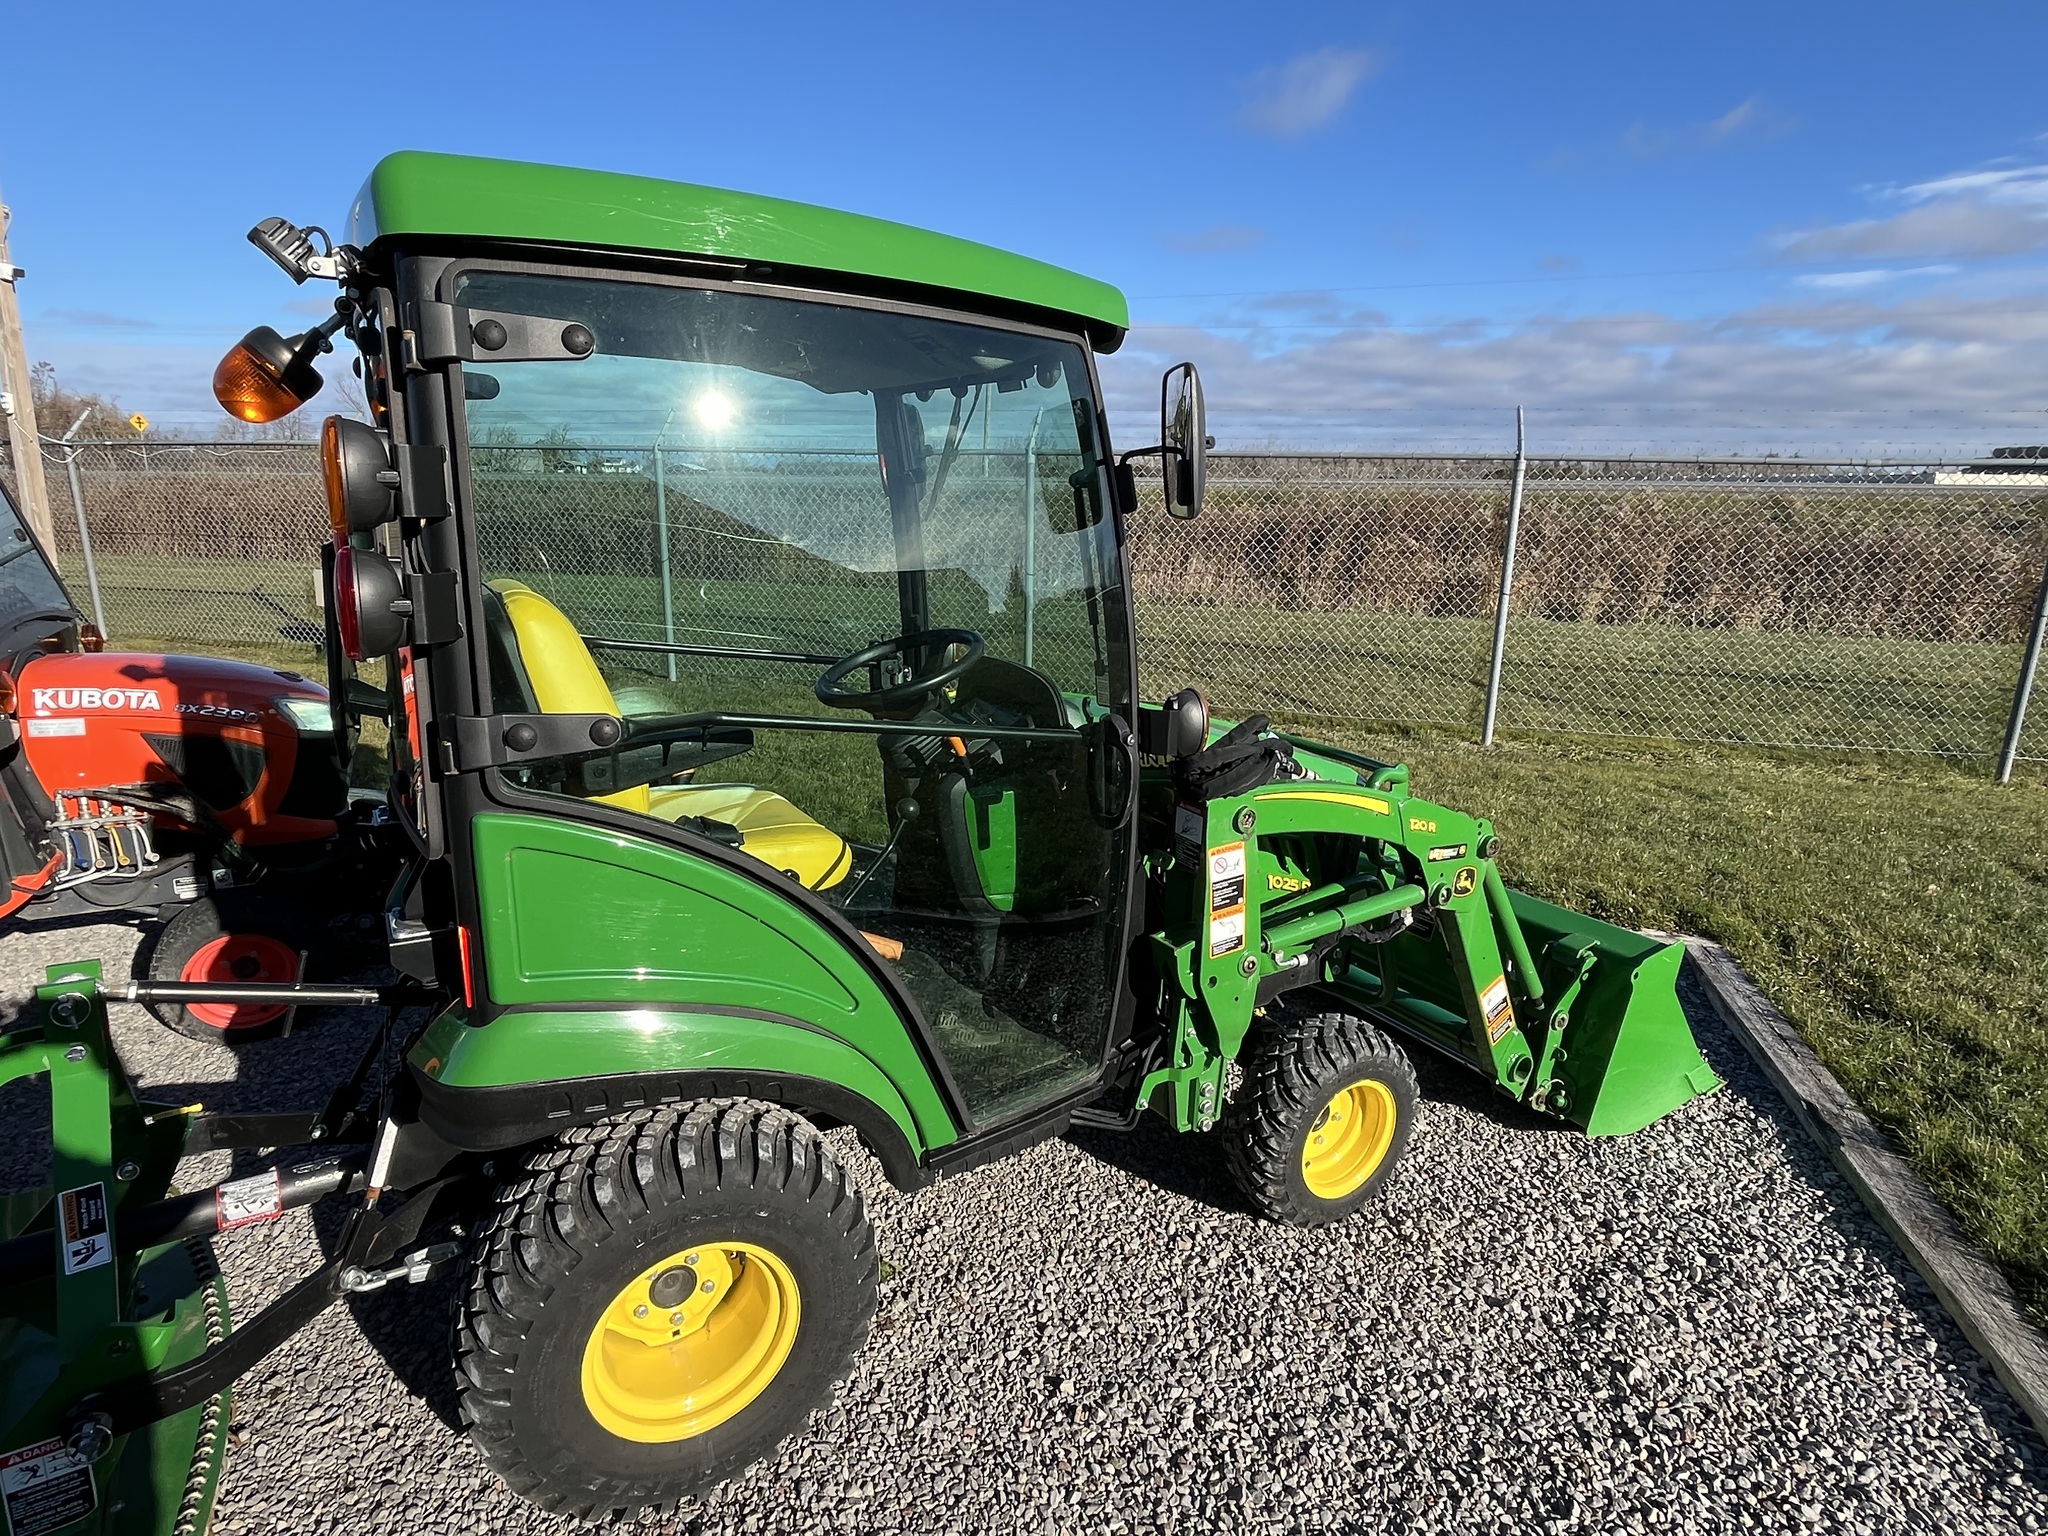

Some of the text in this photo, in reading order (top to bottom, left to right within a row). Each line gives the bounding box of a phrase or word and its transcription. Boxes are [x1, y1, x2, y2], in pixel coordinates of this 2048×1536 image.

[33, 688, 161, 711] KUBOTA
[1409, 817, 1436, 833] 120 R
[1267, 874, 1299, 891] 1025
[66, 1195, 78, 1233] WARNING
[23, 1440, 65, 1459] DANG
